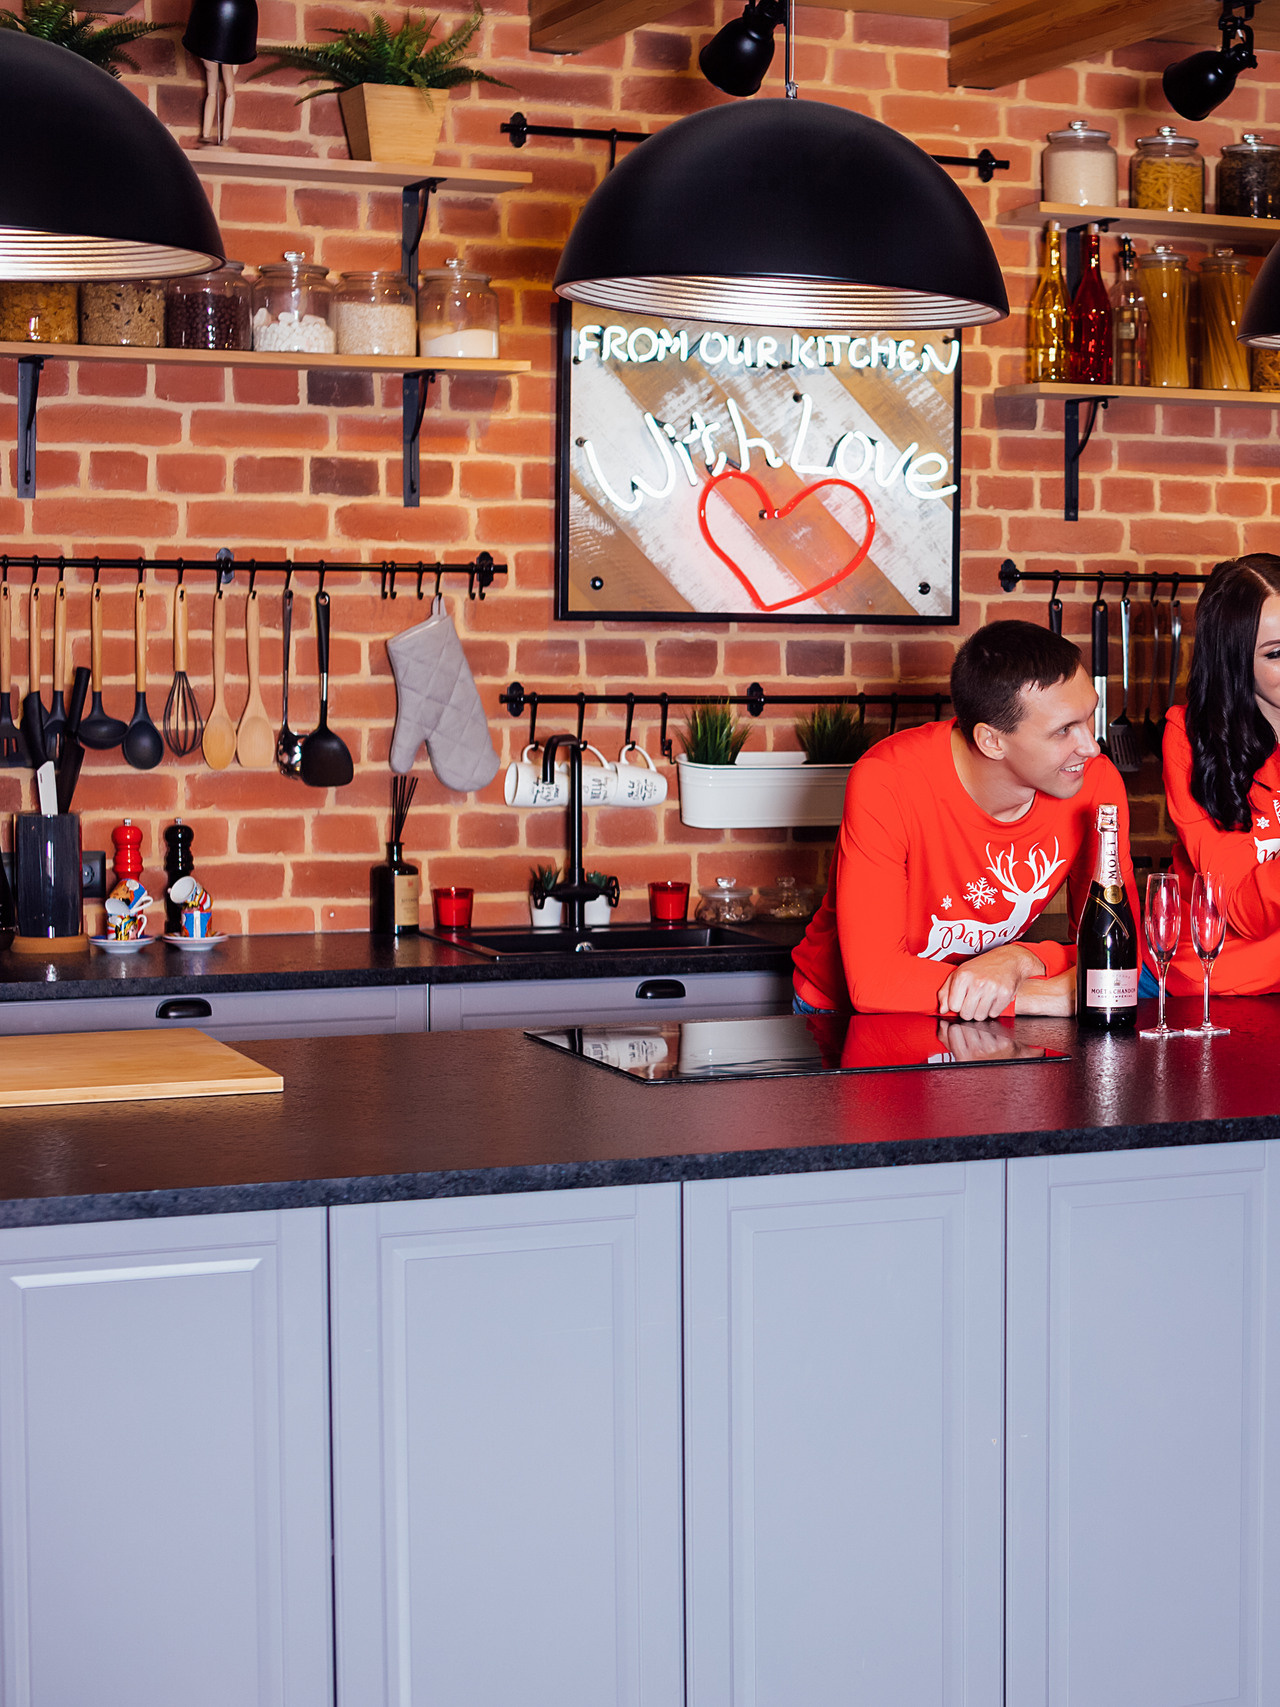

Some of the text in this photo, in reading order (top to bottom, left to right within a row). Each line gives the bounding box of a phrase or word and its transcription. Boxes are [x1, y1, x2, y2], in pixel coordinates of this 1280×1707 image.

[578, 325, 960, 375] FROM OUR KITCHEN
[584, 393, 958, 512] With Love
[938, 923, 1016, 954] Papa
